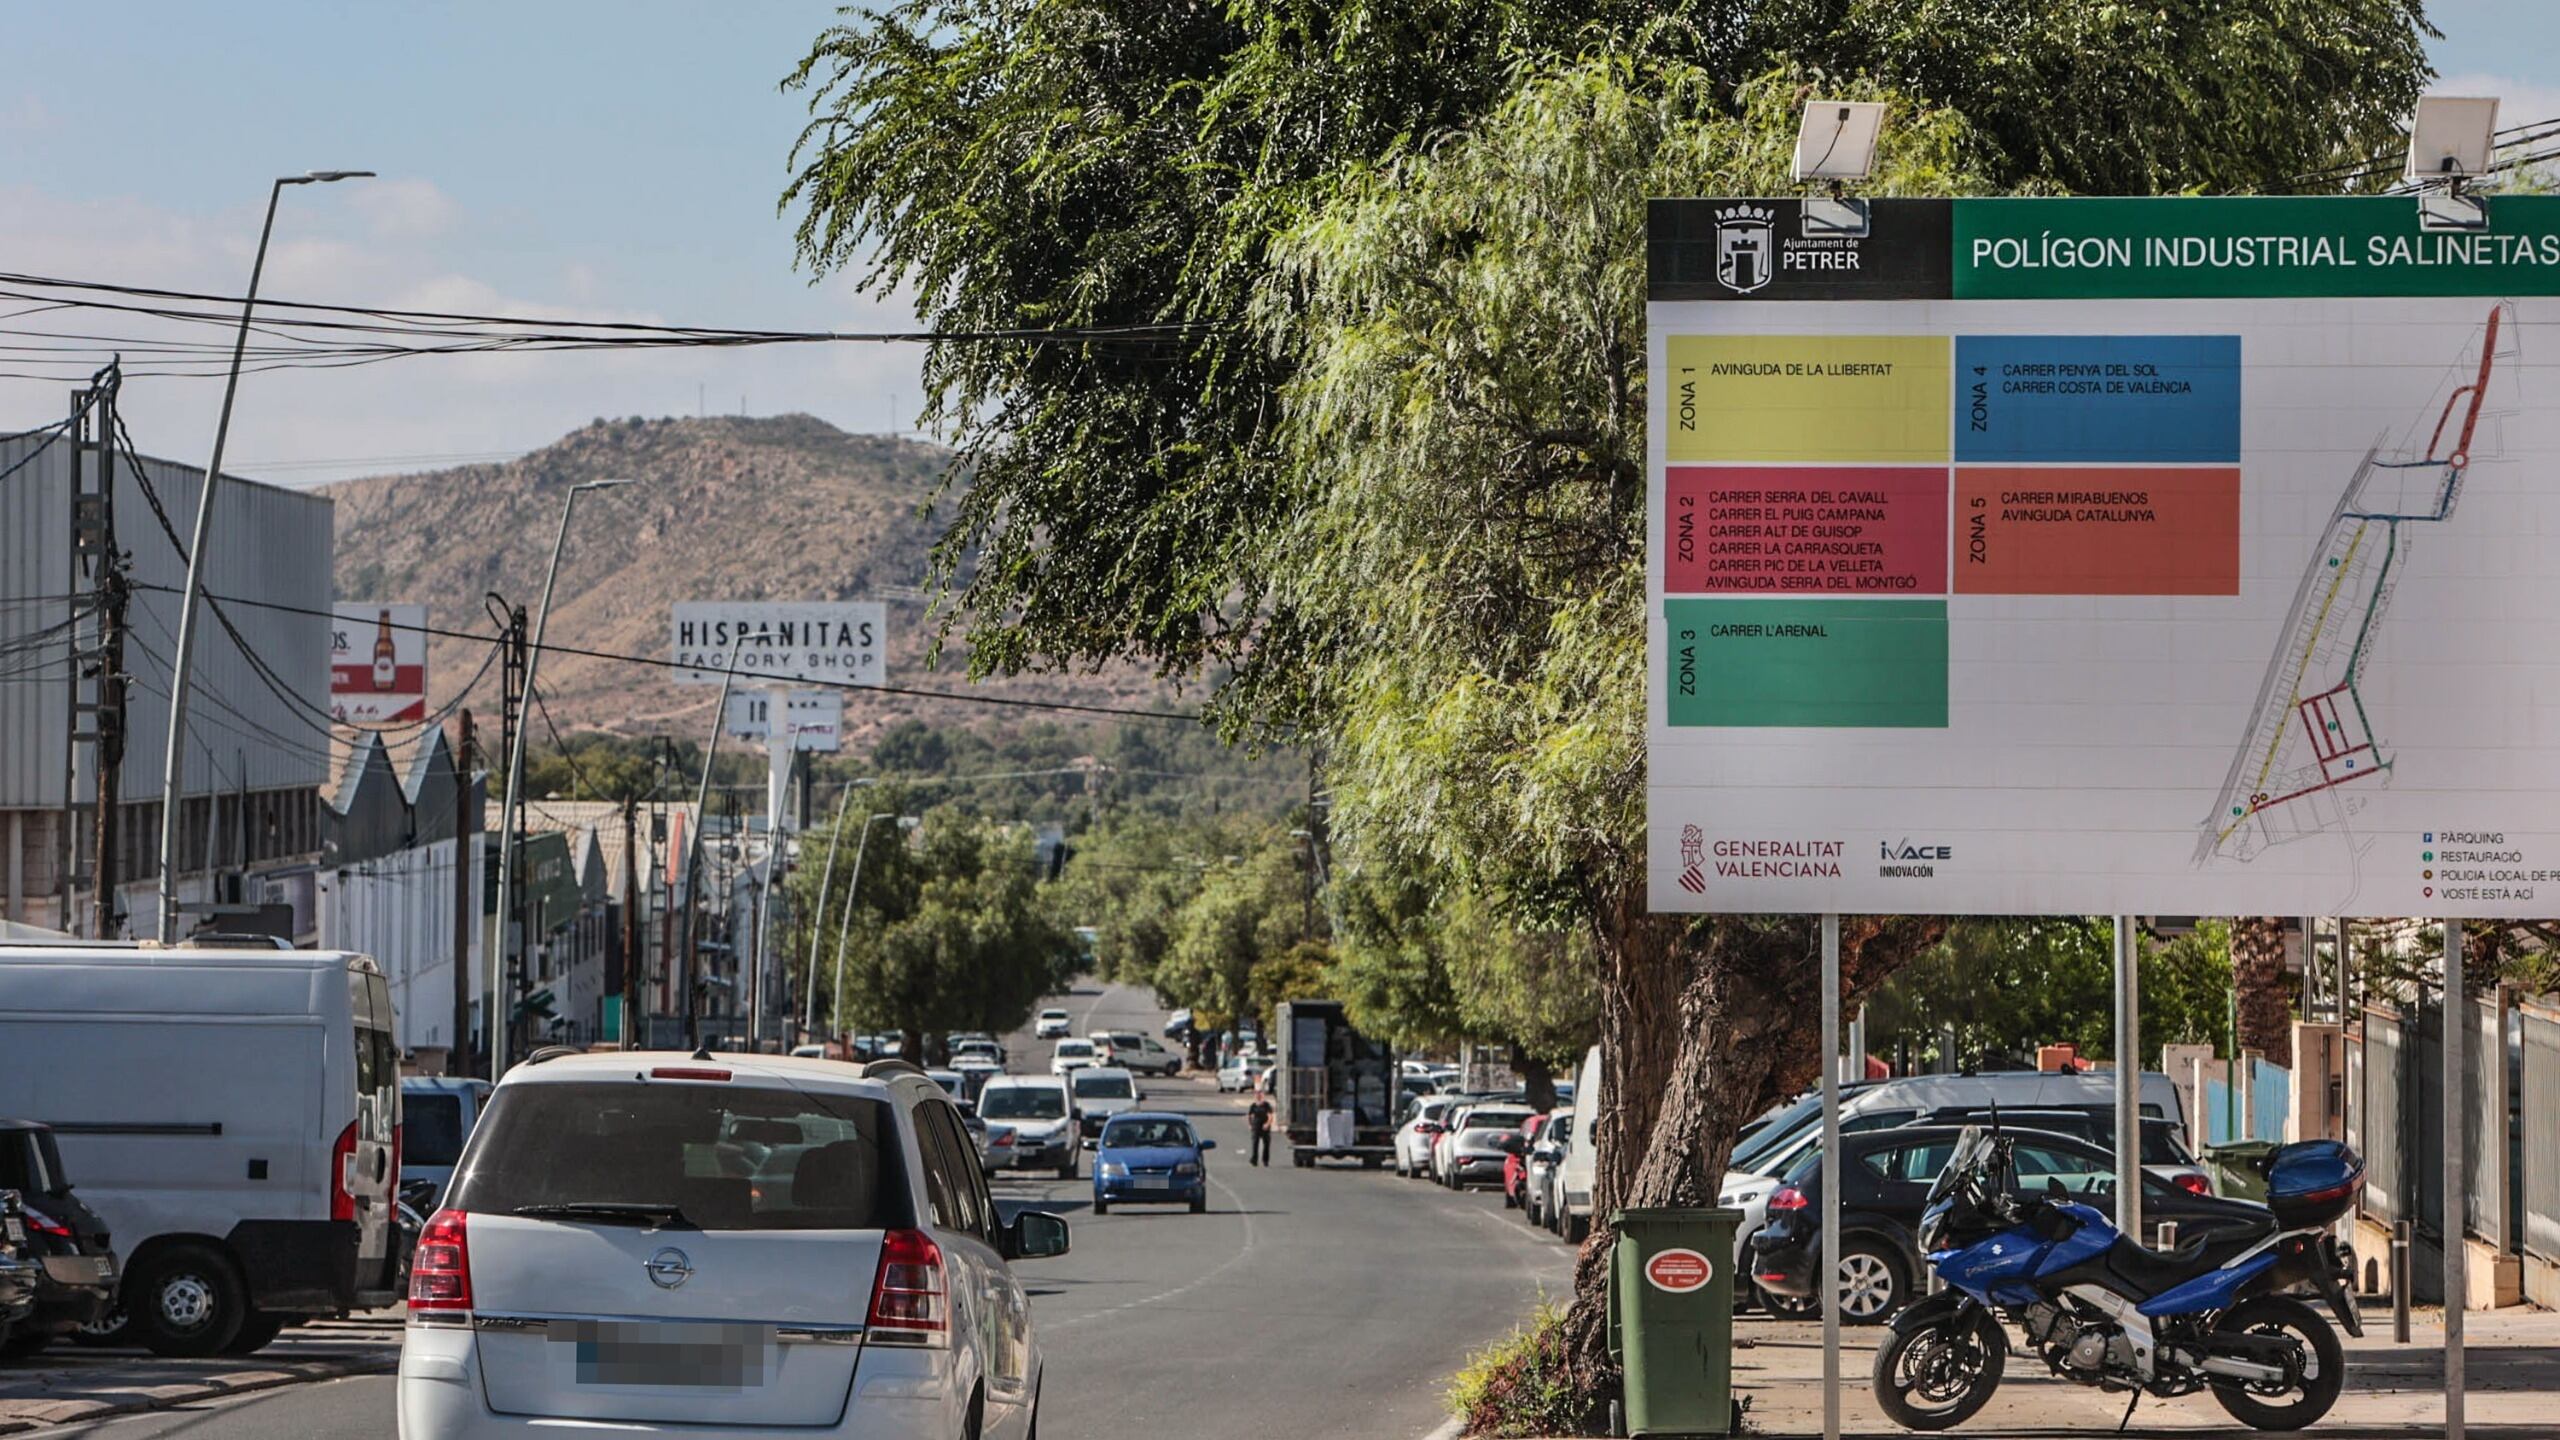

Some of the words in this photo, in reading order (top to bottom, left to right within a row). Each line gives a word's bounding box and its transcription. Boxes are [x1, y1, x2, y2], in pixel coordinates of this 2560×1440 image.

[1784, 238, 1844, 250] Ajuntament
[1846, 238, 1859, 249] de
[1973, 231, 2130, 268] POLÍGON
[2146, 237, 2356, 266] INDUSTRIAL
[2368, 236, 2560, 266] SALINETAS
[1784, 251, 1859, 270] PETRER
[1712, 364, 1781, 375] AVINGUDA
[1786, 364, 1803, 375] DE
[1807, 364, 1823, 375] LA
[1828, 364, 1892, 375] LLIBERTAT
[1974, 367, 1986, 376] 4
[2003, 364, 2055, 376] CARRER
[2059, 365, 2101, 376] PENYA
[2106, 364, 2130, 376] DEL
[2134, 364, 2158, 376] SOL
[2003, 381, 2055, 393] CARRER
[2059, 381, 2101, 393] COSTA
[2107, 382, 2124, 393] DE
[1680, 382, 1695, 430] ZONA
[1972, 383, 1987, 432] ZONA
[1680, 497, 1693, 506] 2
[1710, 491, 1761, 503] CARRER
[1765, 491, 1806, 503] SERRA
[1811, 491, 1835, 503] DEL
[1839, 492, 1888, 504] CAVALL
[1971, 498, 1986, 507] 5
[2001, 492, 2053, 504] CARRER
[2057, 492, 2148, 504] MIRABUENOS
[1710, 508, 1761, 520] CARRER
[1765, 508, 1779, 520] EL
[1783, 508, 1814, 520] PUIG
[1817, 508, 1885, 520] CAMPANA
[2002, 509, 2072, 521] AVINGUDA
[2076, 510, 2155, 521] CATALUNYA
[1679, 513, 1693, 562] ZONA
[1709, 525, 1761, 537] CARRER
[1764, 526, 1787, 537] ALT
[1792, 526, 1808, 537] DE
[1813, 526, 1862, 538] GUISOP
[1970, 514, 1985, 563] ZONA
[1709, 542, 1761, 554] CARRER
[1765, 543, 1781, 554] LA
[1785, 543, 1883, 555] CARRASQUETA
[1709, 559, 1760, 571] CARRER
[1765, 560, 1784, 571] PIC
[1788, 560, 1805, 572] DE
[1809, 560, 1825, 571] LA
[1830, 560, 1883, 572] VELLETA
[1706, 576, 1776, 588] AVINGUDA
[1781, 576, 1822, 589] SERRA
[1827, 576, 1851, 588] DEL
[1856, 574, 1917, 588] MONTGÓ
[681, 622, 872, 647] HISPANITAS
[1681, 630, 1695, 640] 3
[1711, 624, 1762, 636] CARRER
[680, 653, 790, 667] FACORY
[809, 653, 873, 668] SHOP
[1680, 647, 1695, 695] ZONA
[2441, 831, 2504, 844] PÀRQUING
[1714, 841, 1844, 856] GENERALITAT
[2441, 850, 2522, 862] RESTAURACIÓ
[1716, 862, 1840, 877] VALENCIANA
[1880, 864, 1934, 878] INNOVACIÓN
[2441, 870, 2485, 881] POLICIA
[2489, 870, 2528, 881] LOCAL
[2532, 871, 2546, 881] DE
[2514, 887, 2534, 900] ACÍ
